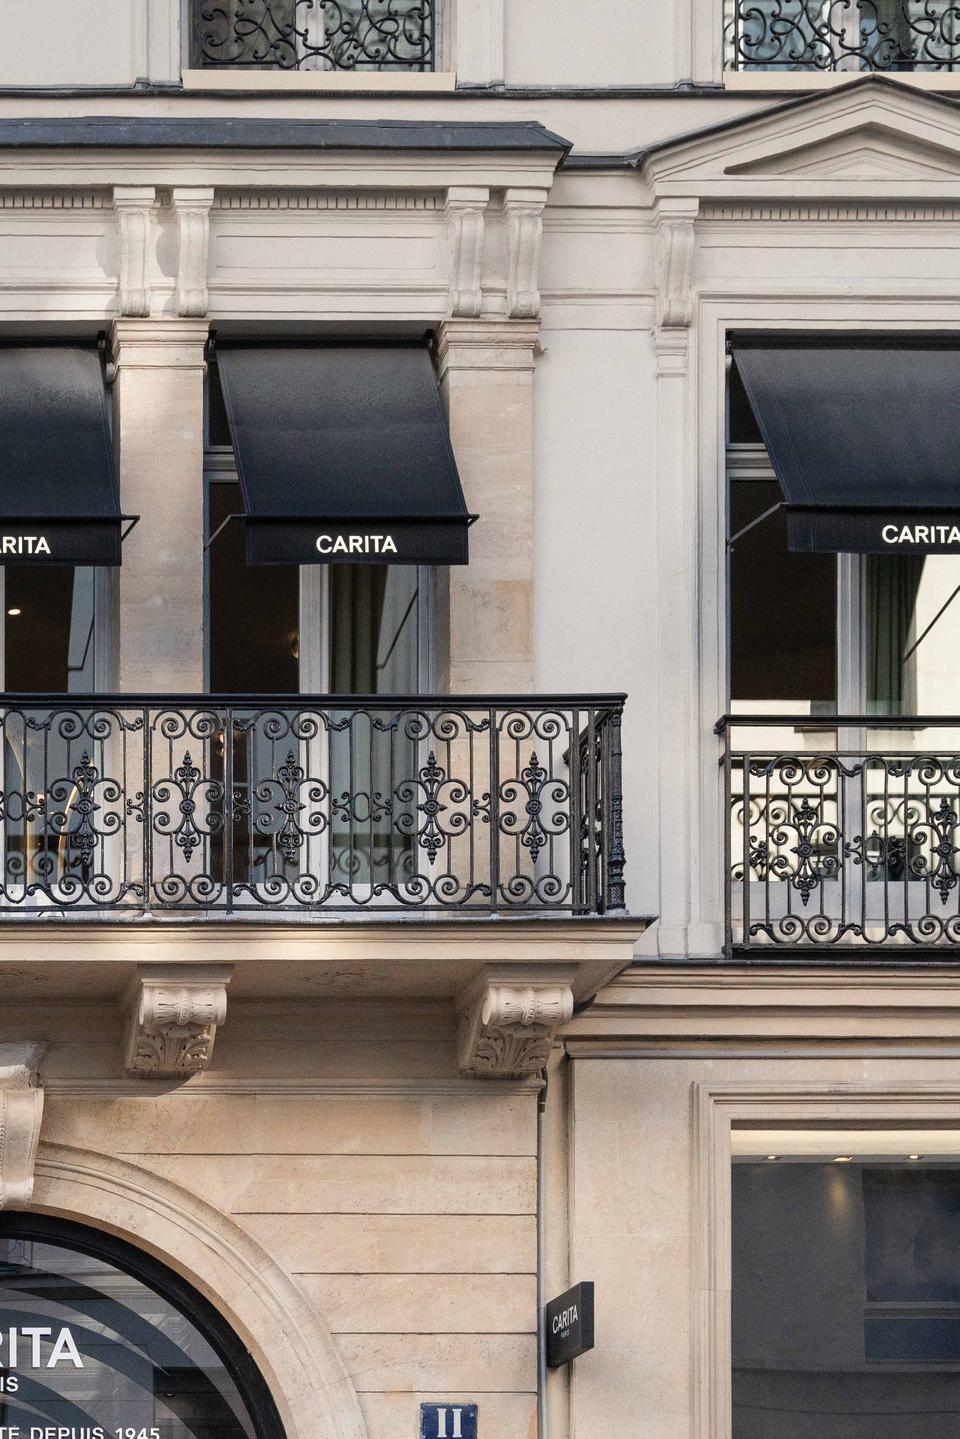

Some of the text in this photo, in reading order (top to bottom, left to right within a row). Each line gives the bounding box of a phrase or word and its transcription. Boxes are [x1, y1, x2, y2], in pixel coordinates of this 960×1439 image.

[315, 534, 398, 554] CARITA
[881, 524, 960, 544] CARITA
[552, 1304, 579, 1334] CARITA
